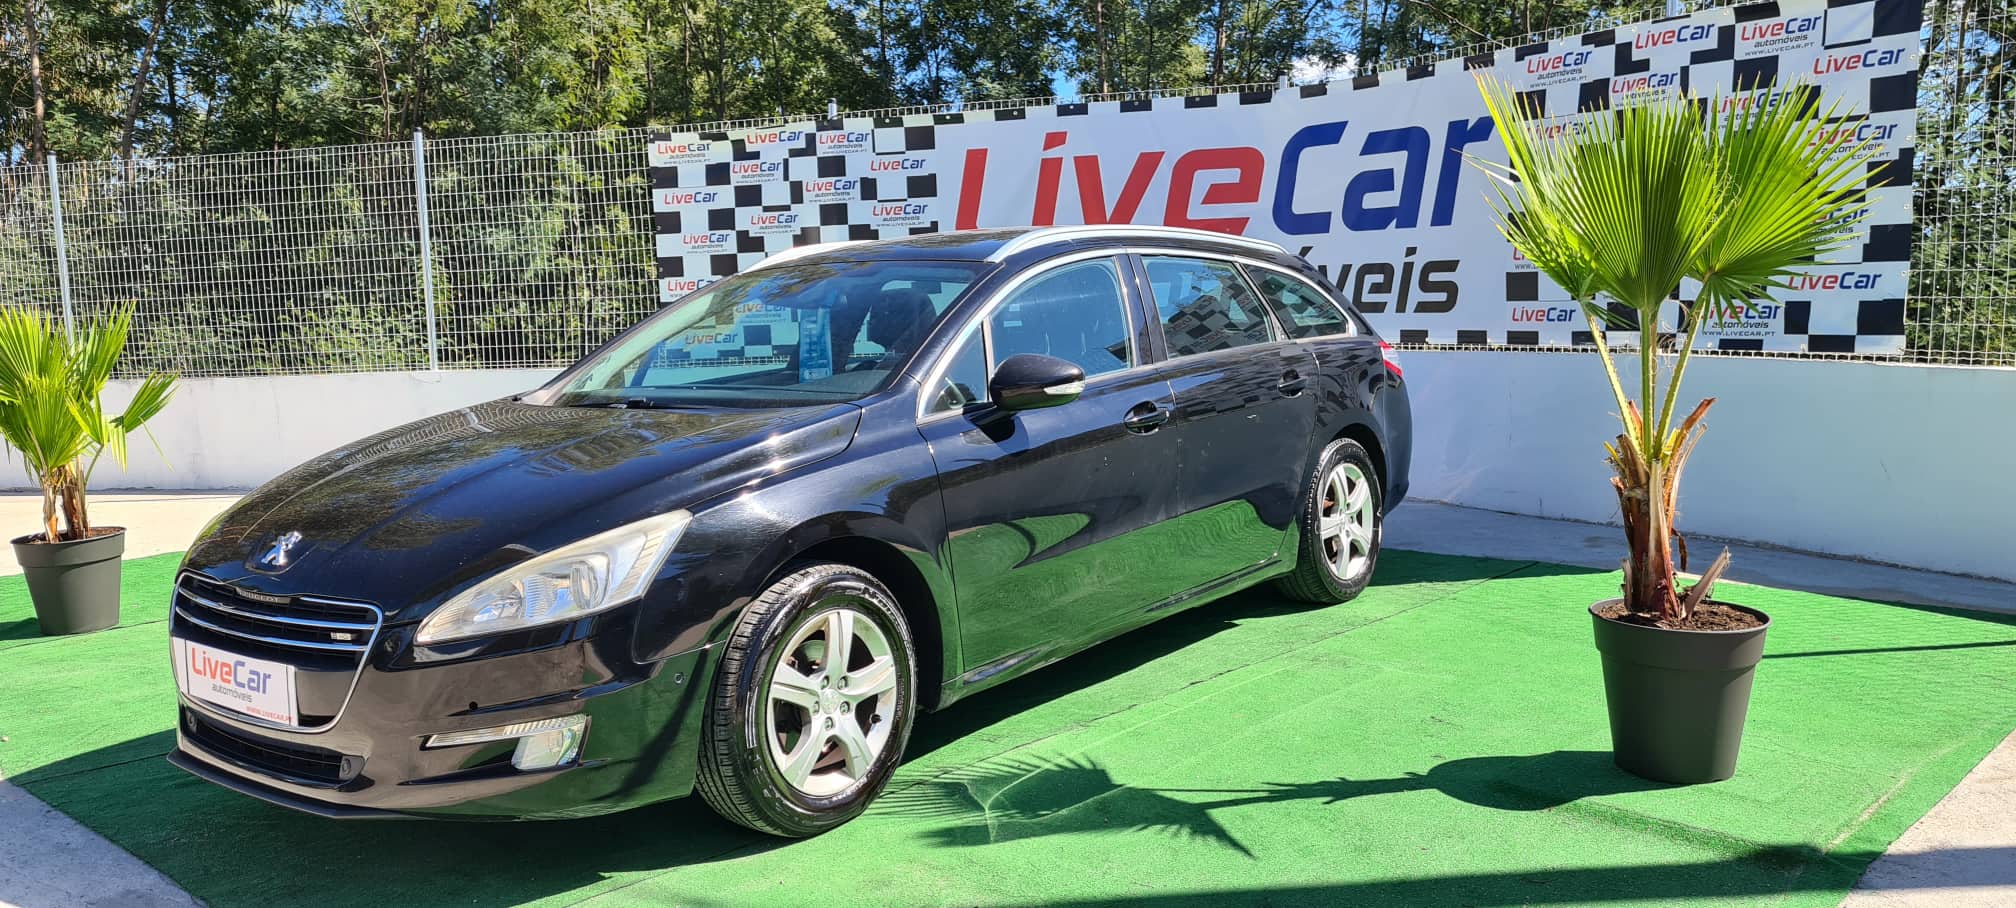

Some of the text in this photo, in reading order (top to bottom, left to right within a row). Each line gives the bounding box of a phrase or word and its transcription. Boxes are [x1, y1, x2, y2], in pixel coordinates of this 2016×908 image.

[1741, 15, 1822, 41] LiveCar
[1634, 23, 1715, 49] LiveCar
[1754, 33, 1808, 48] automóveis
[1745, 42, 1815, 57] WWW.LIVECAR.PT
[1527, 51, 1592, 73] LiveCar
[1813, 48, 1906, 75] LiveCar
[1537, 68, 1582, 80] automóveis
[1612, 72, 1678, 94] LiveCar
[747, 131, 804, 144] LiveCar
[819, 132, 870, 144] LiveCar
[657, 142, 711, 154] LiveCar
[732, 161, 781, 173] LiveCar
[870, 158, 926, 171] LiveCar
[955, 120, 1494, 235] LiveCar
[805, 179, 858, 192] LiveCar
[664, 192, 718, 205] LiveCar
[872, 204, 928, 217] LiveCar
[751, 213, 799, 225] LiveCar
[683, 232, 730, 245] LiveCar
[1788, 272, 1882, 291] LiveCar
[1512, 306, 1576, 322] LiveCar
[191, 647, 271, 694] LiveCar
[211, 683, 253, 702] automóveis
